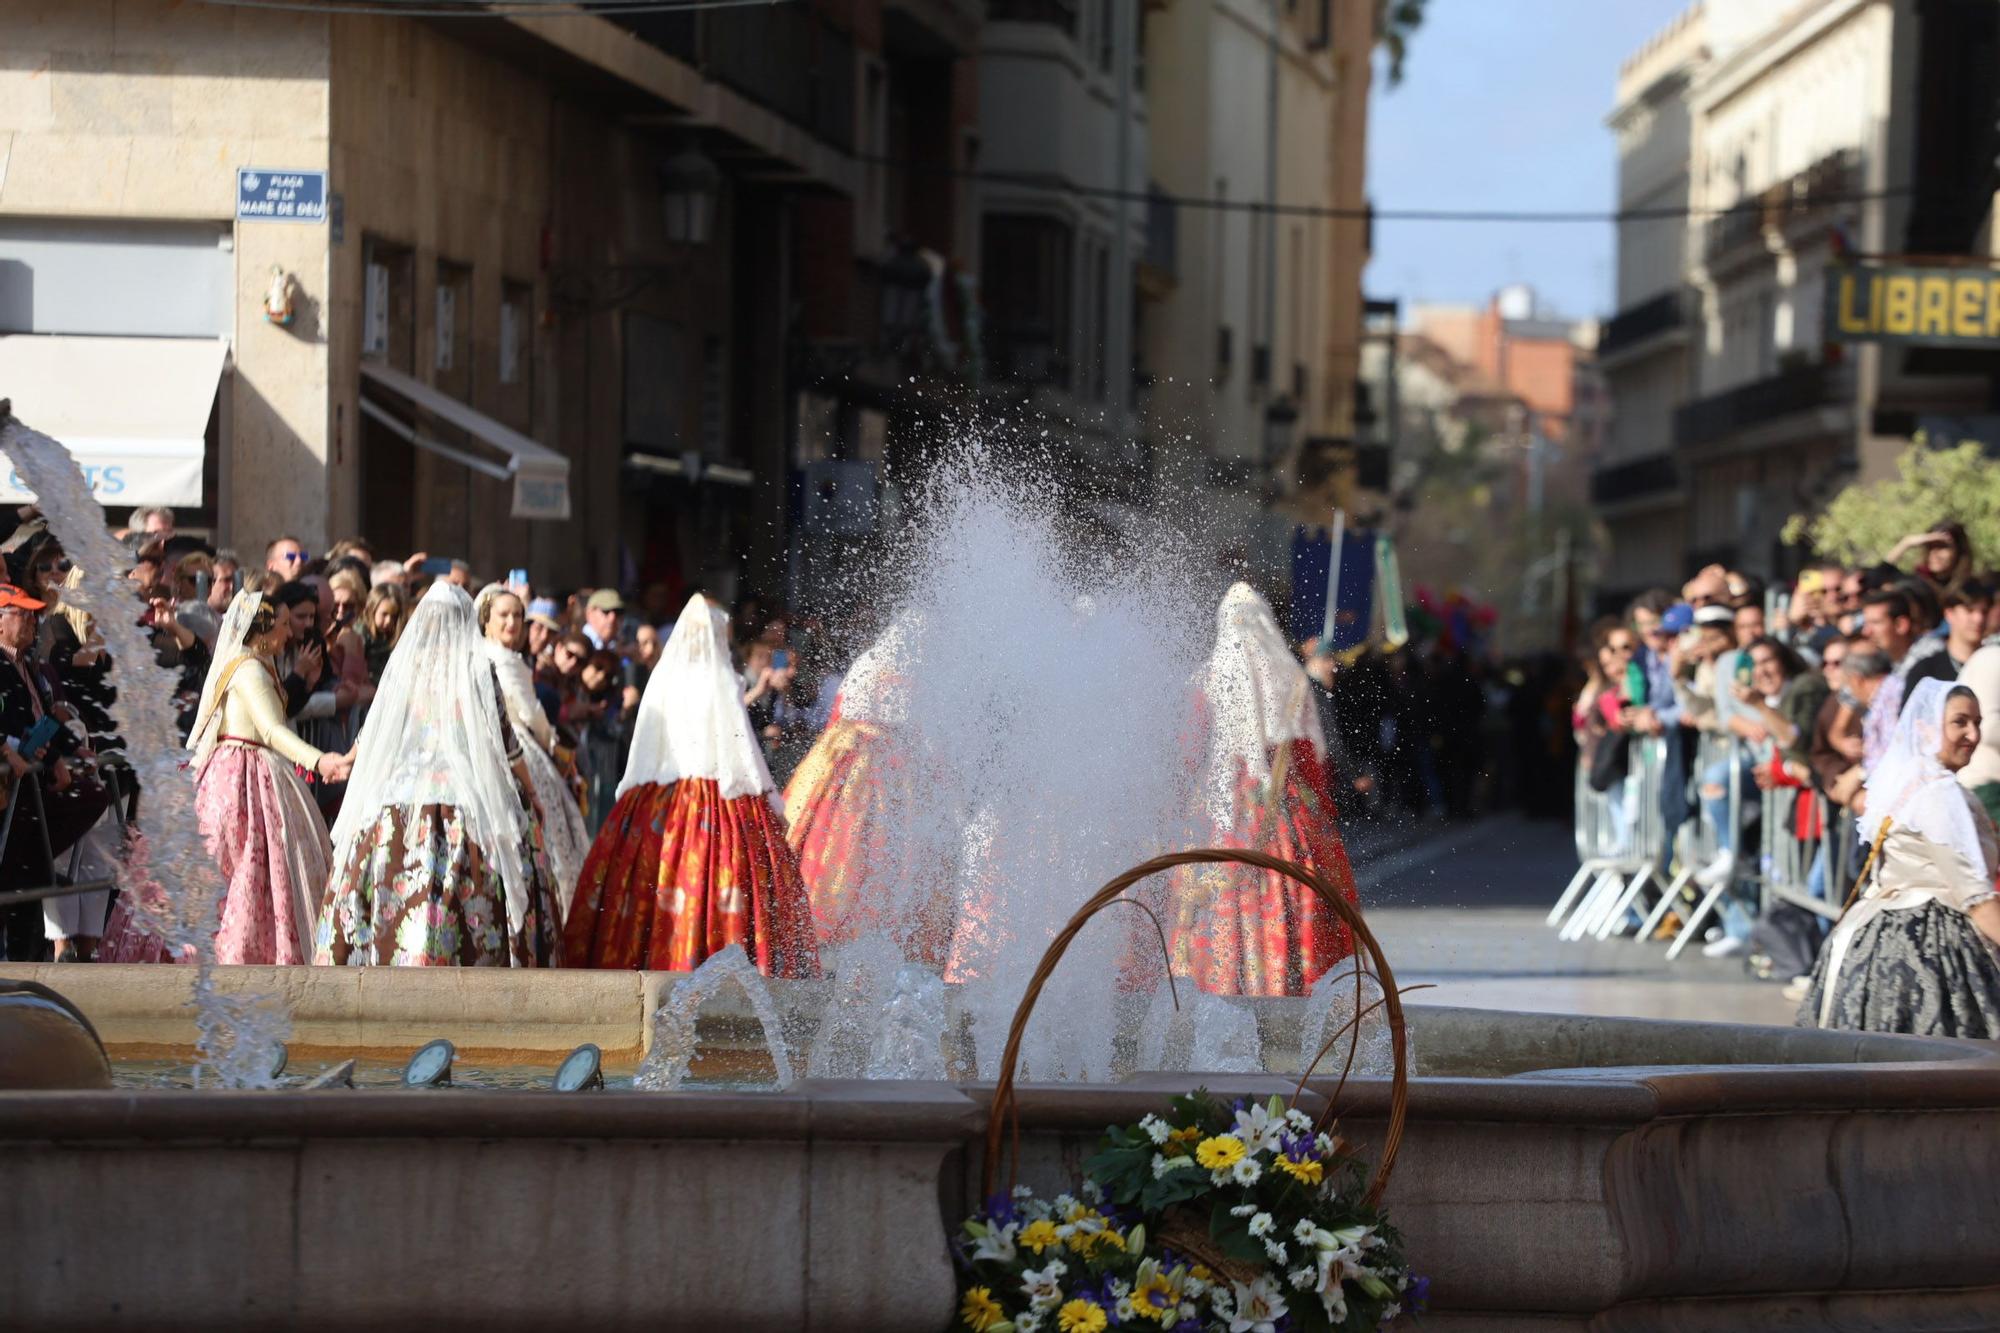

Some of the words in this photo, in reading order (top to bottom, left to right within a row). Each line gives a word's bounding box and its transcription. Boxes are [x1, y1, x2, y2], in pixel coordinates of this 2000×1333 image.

[266, 188, 280, 200] DE
[282, 188, 296, 200] LA
[240, 200, 275, 215] MARE
[277, 201, 295, 216] DE
